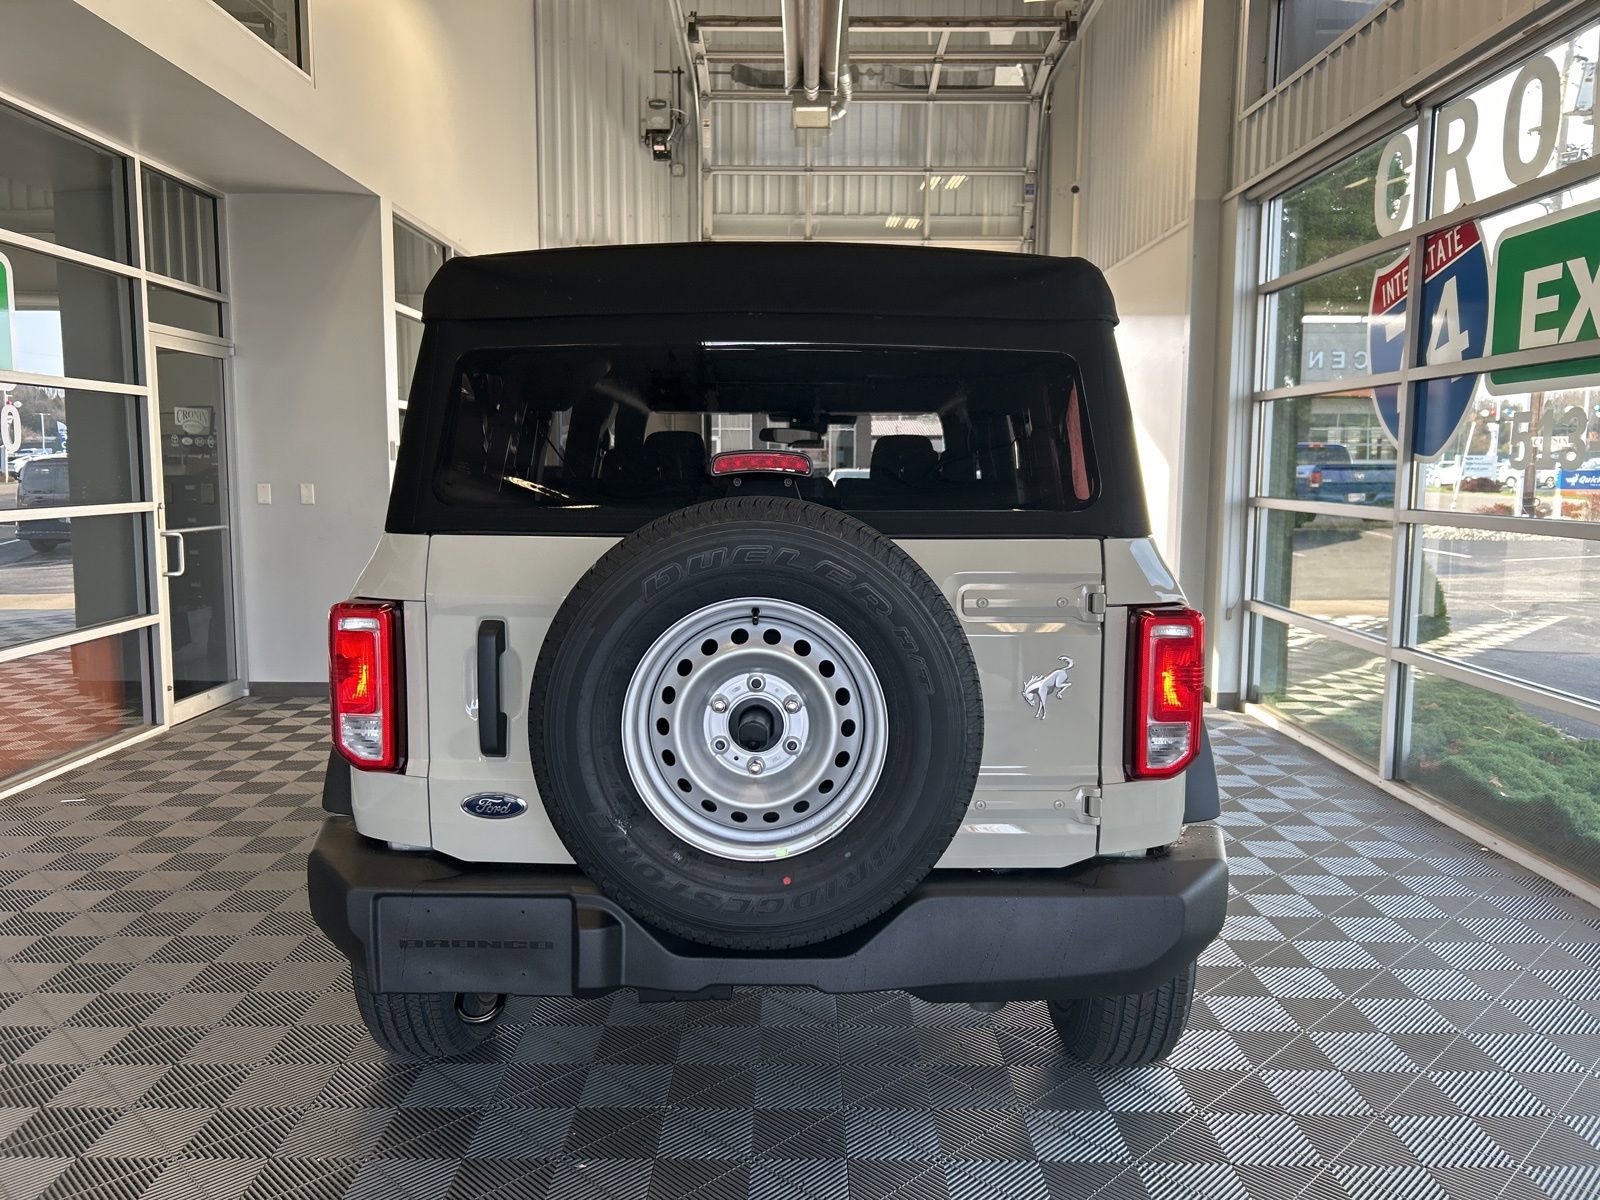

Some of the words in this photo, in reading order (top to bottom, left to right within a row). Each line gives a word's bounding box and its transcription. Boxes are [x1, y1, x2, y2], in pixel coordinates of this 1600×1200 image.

[1374, 56, 1600, 238] CRO
[1382, 225, 1463, 307] INTETATE
[640, 544, 894, 618] DUELER
[475, 798, 511, 814] Ford
[400, 939, 553, 950] BRONCO
